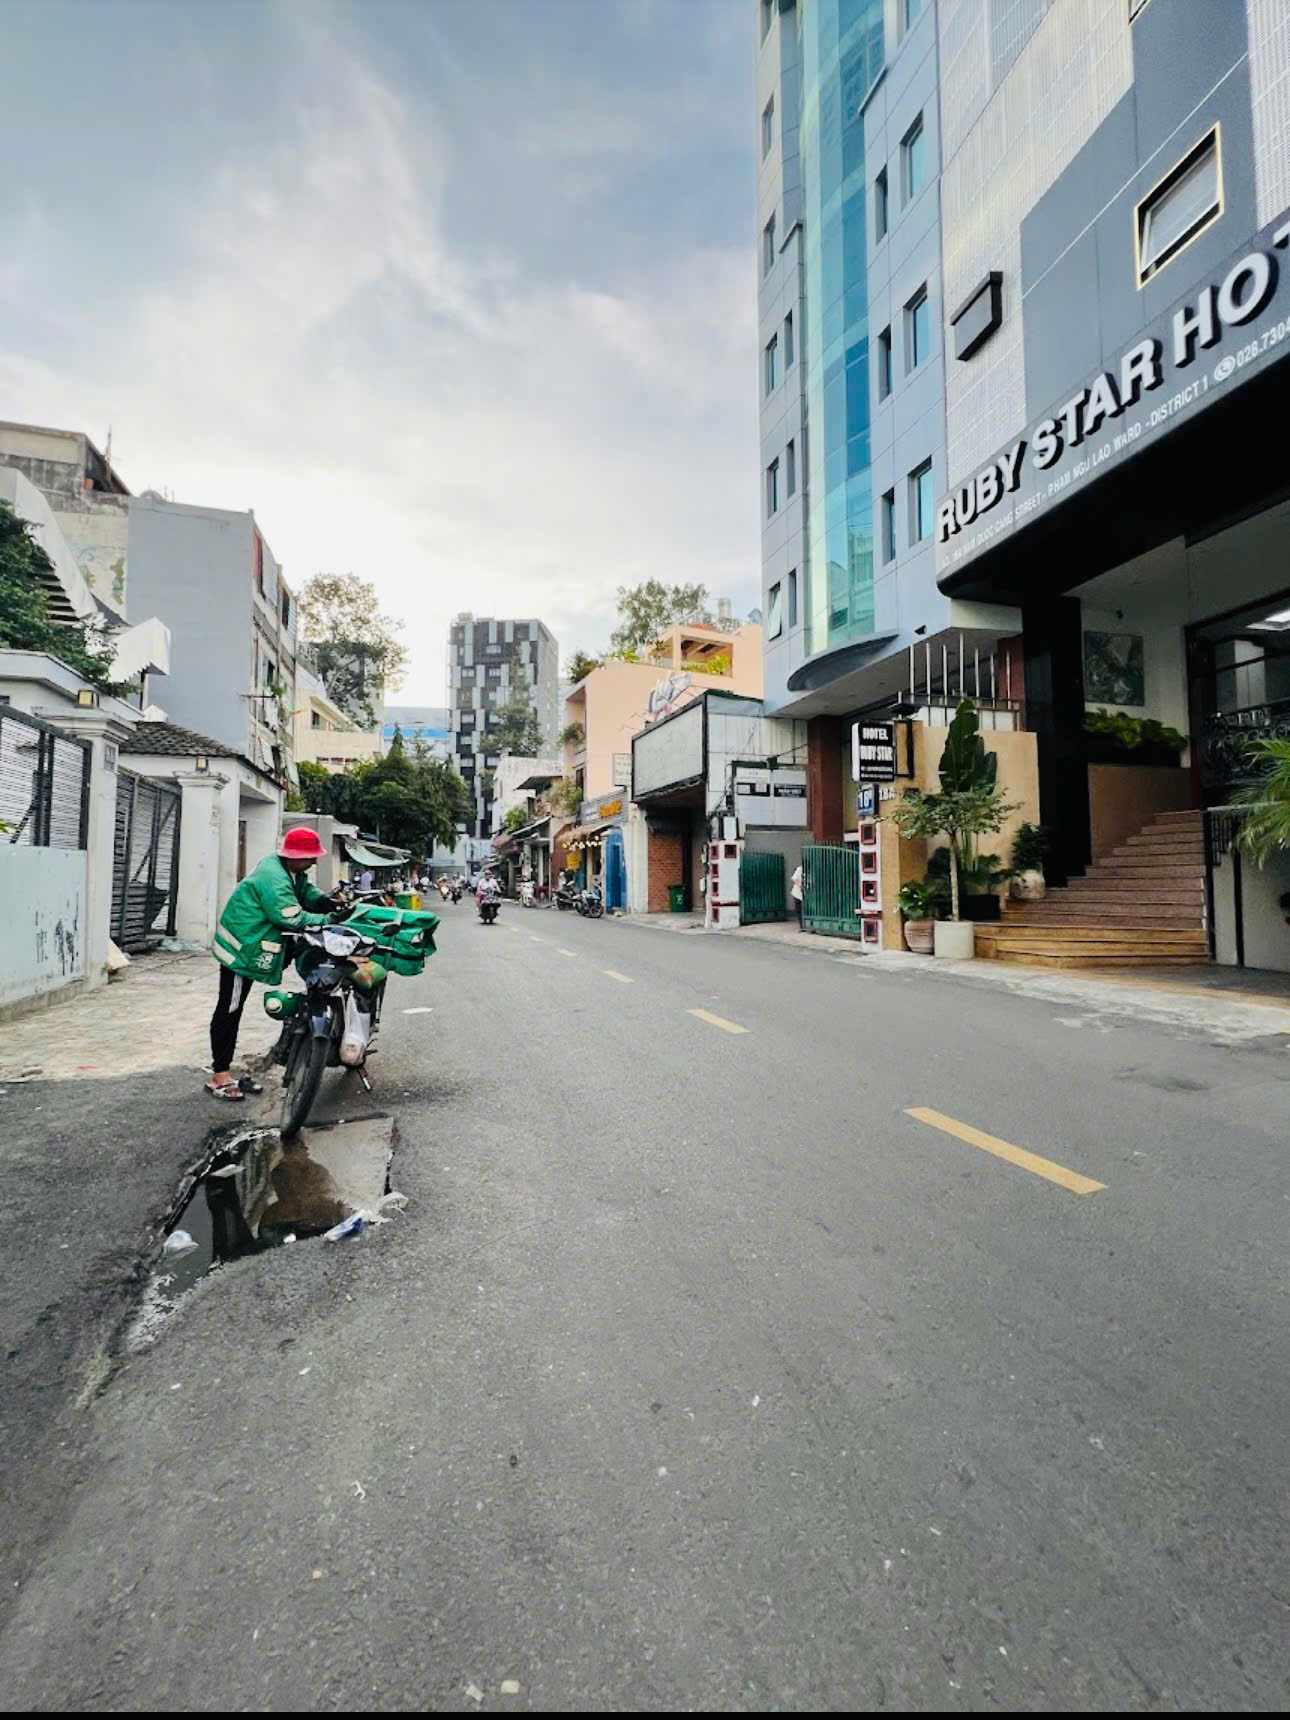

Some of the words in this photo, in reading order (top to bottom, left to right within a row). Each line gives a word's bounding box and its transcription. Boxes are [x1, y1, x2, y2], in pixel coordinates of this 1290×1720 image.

[937, 441, 1026, 542] RUBY
[1031, 338, 1163, 470] STAR
[1092, 443, 1111, 467] LAO
[1113, 422, 1141, 452] WARD
[1202, 375, 1208, 391] 1
[862, 727, 889, 741] HOTEL
